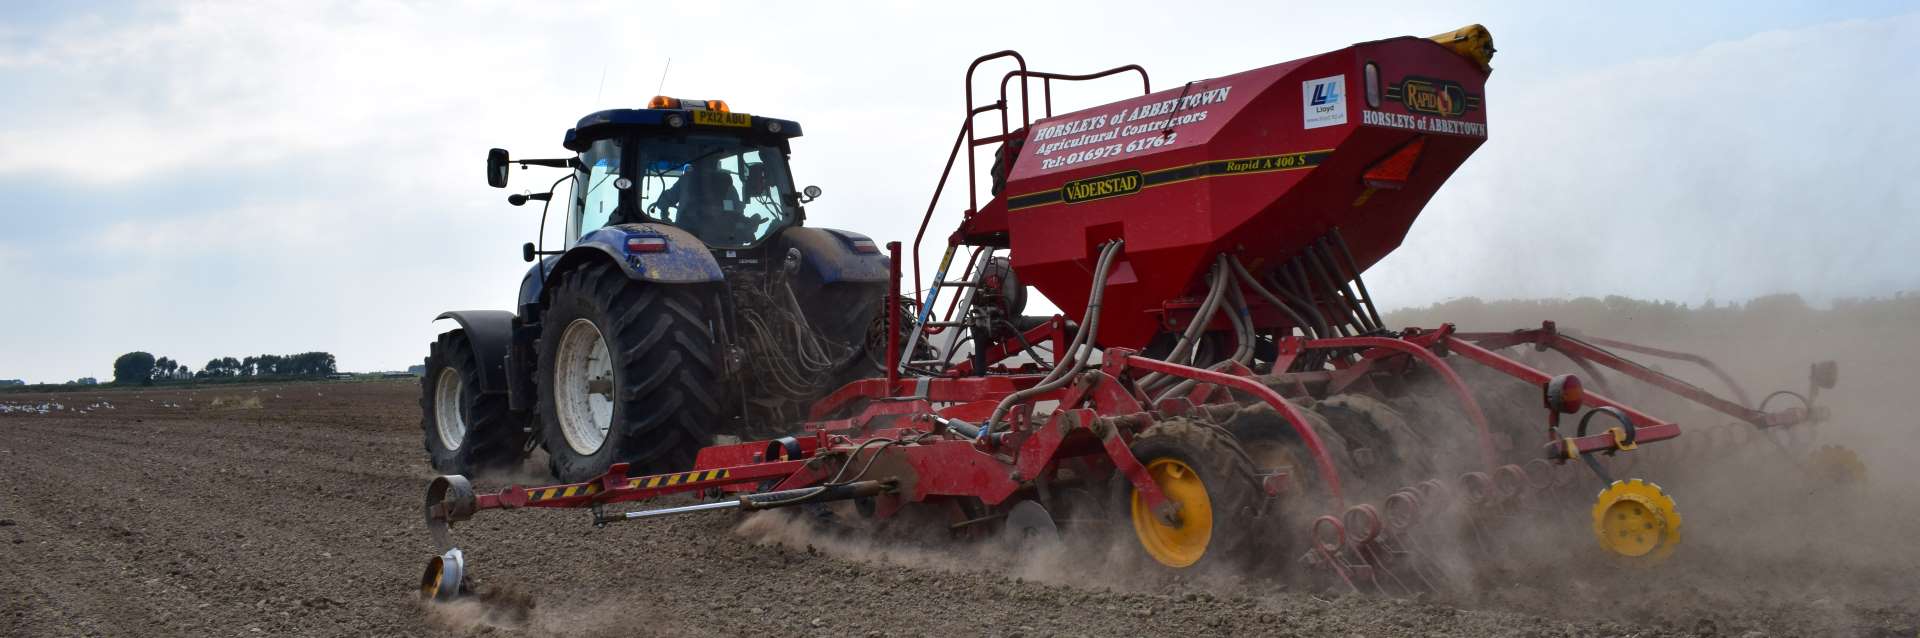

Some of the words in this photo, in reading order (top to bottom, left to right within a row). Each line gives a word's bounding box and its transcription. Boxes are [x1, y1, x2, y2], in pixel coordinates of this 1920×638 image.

[700, 111, 722, 124] PX12
[1034, 114, 1106, 142] HORSLEYS
[1110, 109, 1128, 126] of
[1127, 86, 1232, 122] ABBEYTOWN
[1316, 105, 1335, 113] Lloyd
[1036, 126, 1118, 155] Agricultural
[1122, 110, 1208, 137] Contractors
[1362, 110, 1416, 129] HORSLEYS
[1417, 116, 1428, 130] of
[1429, 118, 1485, 136] ABBEYTOWN
[1066, 143, 1122, 165] 016973
[1125, 132, 1178, 153] 61762
[1226, 159, 1259, 172] Rapid
[1262, 158, 1273, 169] A
[1276, 155, 1294, 168] 400
[1298, 155, 1306, 166] S
[1066, 175, 1137, 201] VÄDERSTAD
